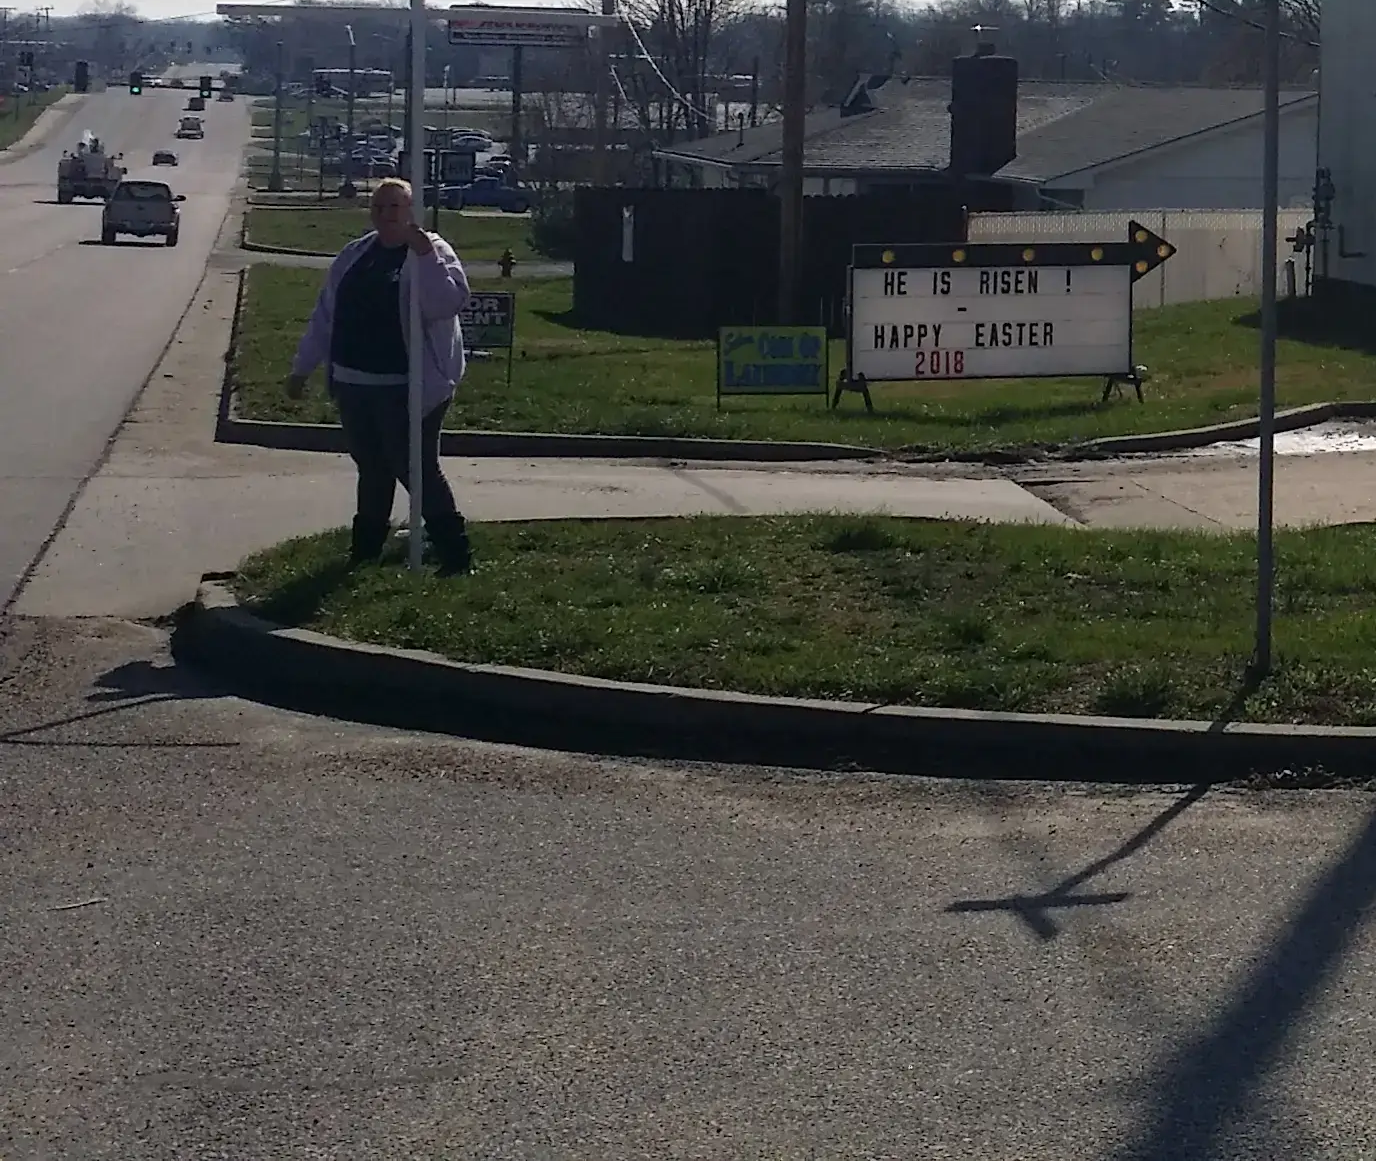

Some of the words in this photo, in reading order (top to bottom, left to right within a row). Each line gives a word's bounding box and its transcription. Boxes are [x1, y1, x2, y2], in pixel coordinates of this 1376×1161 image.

[884, 270, 908, 296] HE
[933, 270, 951, 295] IS
[980, 269, 1038, 295] RISEN
[468, 298, 500, 311] OR
[460, 312, 507, 325] ENT
[874, 323, 941, 349] HAPPY
[975, 322, 1054, 347] EASTER
[915, 351, 964, 376] 2018
